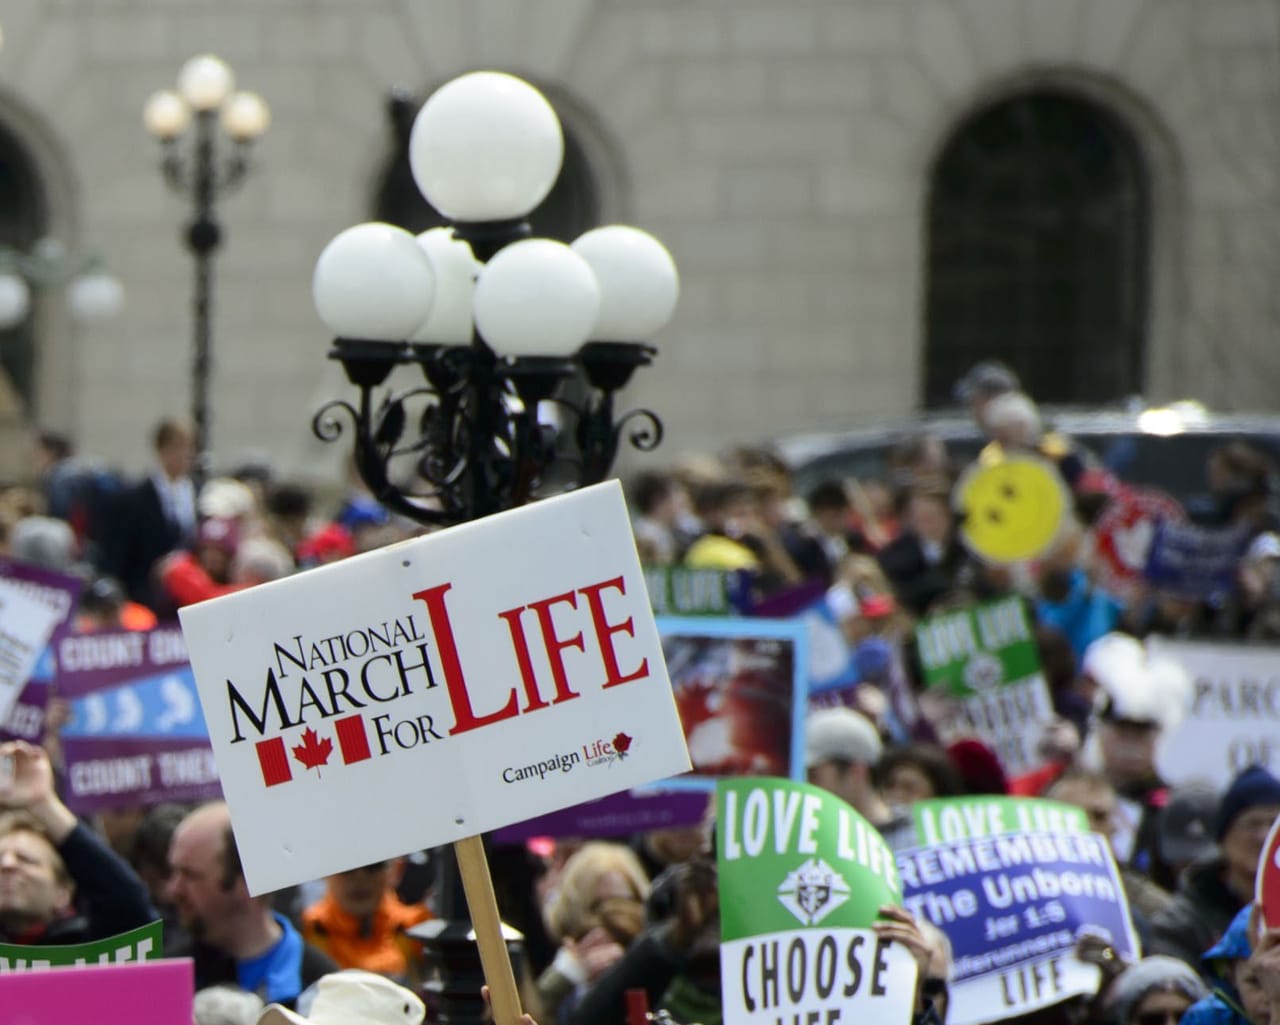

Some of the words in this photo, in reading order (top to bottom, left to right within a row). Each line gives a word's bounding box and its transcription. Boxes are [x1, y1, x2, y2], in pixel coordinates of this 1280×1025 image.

[59, 631, 144, 674] COUNT
[148, 628, 190, 666] ON
[272, 614, 426, 679] NATIONAL
[371, 714, 445, 756] FOR
[411, 575, 651, 737] LIFE
[225, 643, 438, 745] MARCH
[70, 753, 153, 798] COUNT
[502, 751, 581, 784] Campaign
[582, 739, 612, 761] Life
[723, 787, 824, 861] LOVE
[837, 807, 900, 895] LIFE
[920, 803, 1005, 847] LOVE
[1015, 803, 1083, 836] LIFE
[897, 832, 1106, 888] REMEMBER
[904, 887, 978, 926] The
[982, 867, 1118, 908] Unborn
[741, 933, 895, 1014] CHOOSE
[999, 959, 1062, 1007] LIFE
